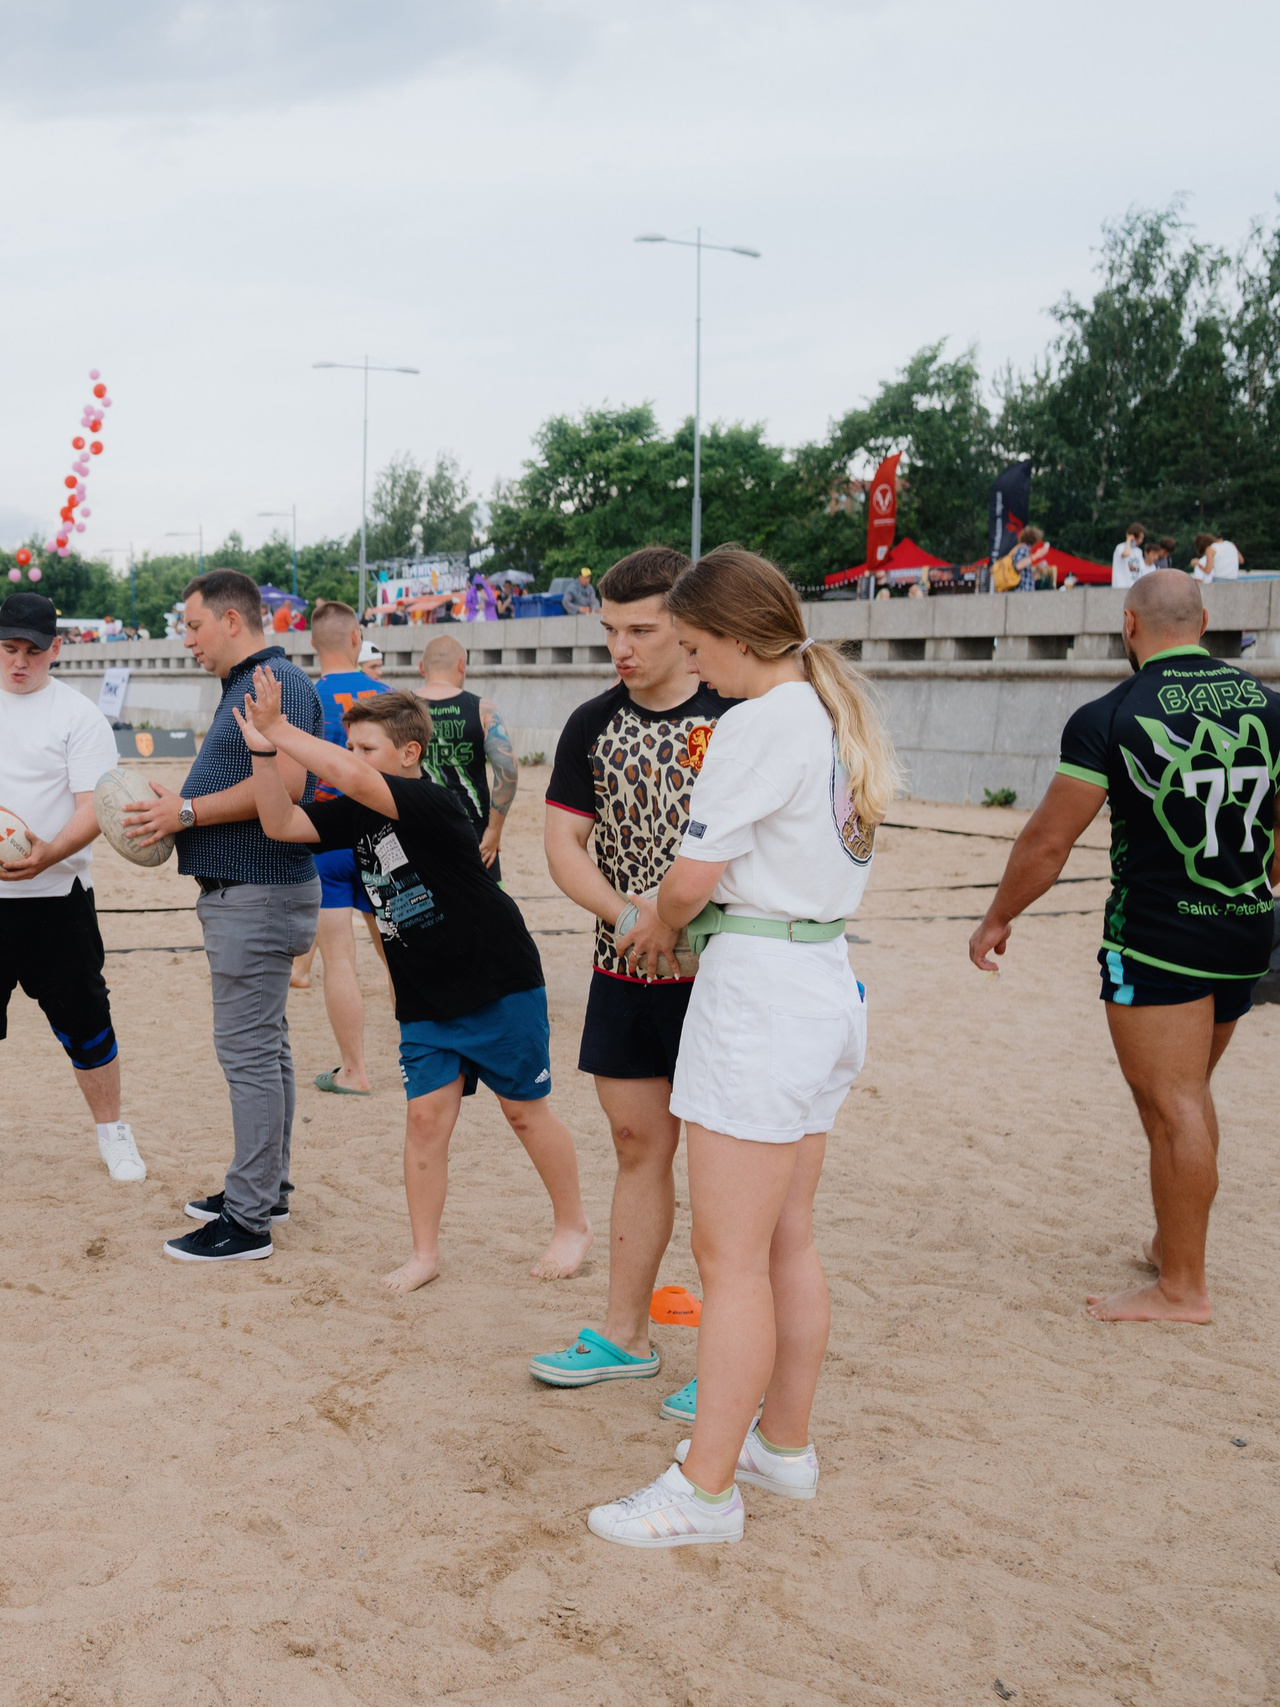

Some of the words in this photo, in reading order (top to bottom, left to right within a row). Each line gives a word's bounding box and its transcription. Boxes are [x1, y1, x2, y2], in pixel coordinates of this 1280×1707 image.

[1157, 679, 1267, 717] BARS
[421, 742, 474, 768] ARS
[1183, 766, 1270, 858] 77
[410, 893, 428, 906] person
